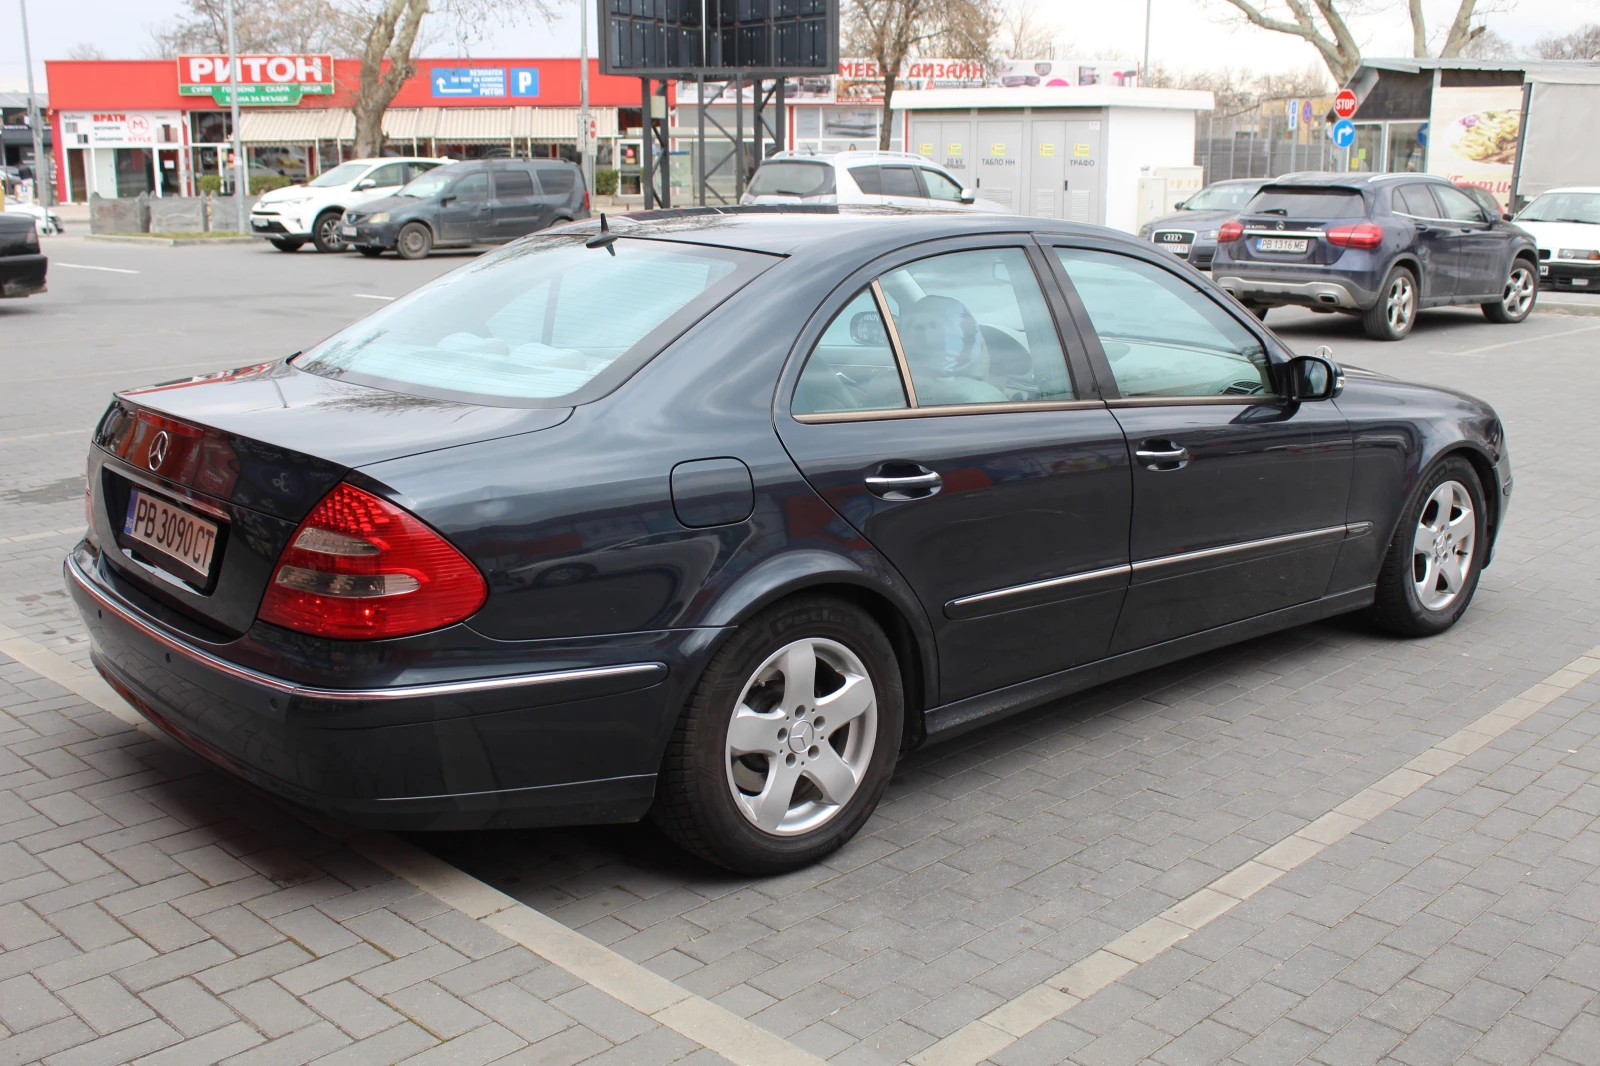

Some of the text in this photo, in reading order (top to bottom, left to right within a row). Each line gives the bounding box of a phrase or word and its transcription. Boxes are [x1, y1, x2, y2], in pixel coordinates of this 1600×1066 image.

[188, 57, 323, 83] РИТОН
[1335, 98, 1355, 111] STOP
[981, 158, 1016, 167] ТАБЛО НН
[1069, 159, 1096, 167] ТРАФО
[1261, 239, 1306, 250] PB 1316 ME
[134, 498, 215, 568] PB 3090 CT
